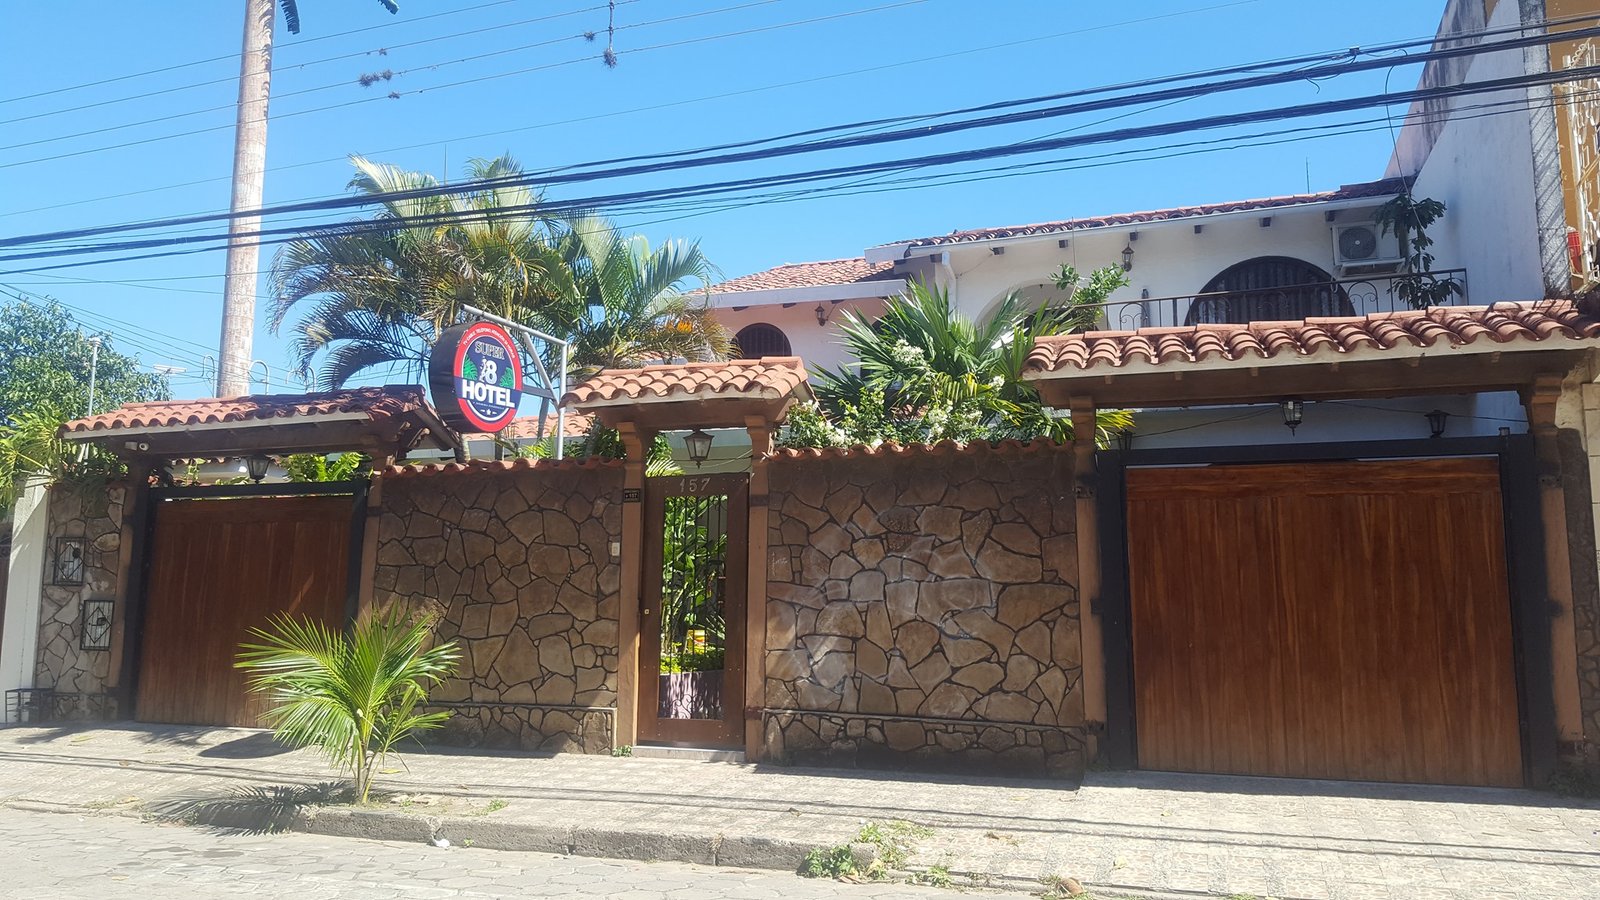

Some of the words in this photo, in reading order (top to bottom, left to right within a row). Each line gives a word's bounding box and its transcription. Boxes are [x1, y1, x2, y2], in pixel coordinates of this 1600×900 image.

[474, 340, 505, 360] SUPER
[462, 379, 515, 408] HOTEL
[679, 477, 711, 493] 157
